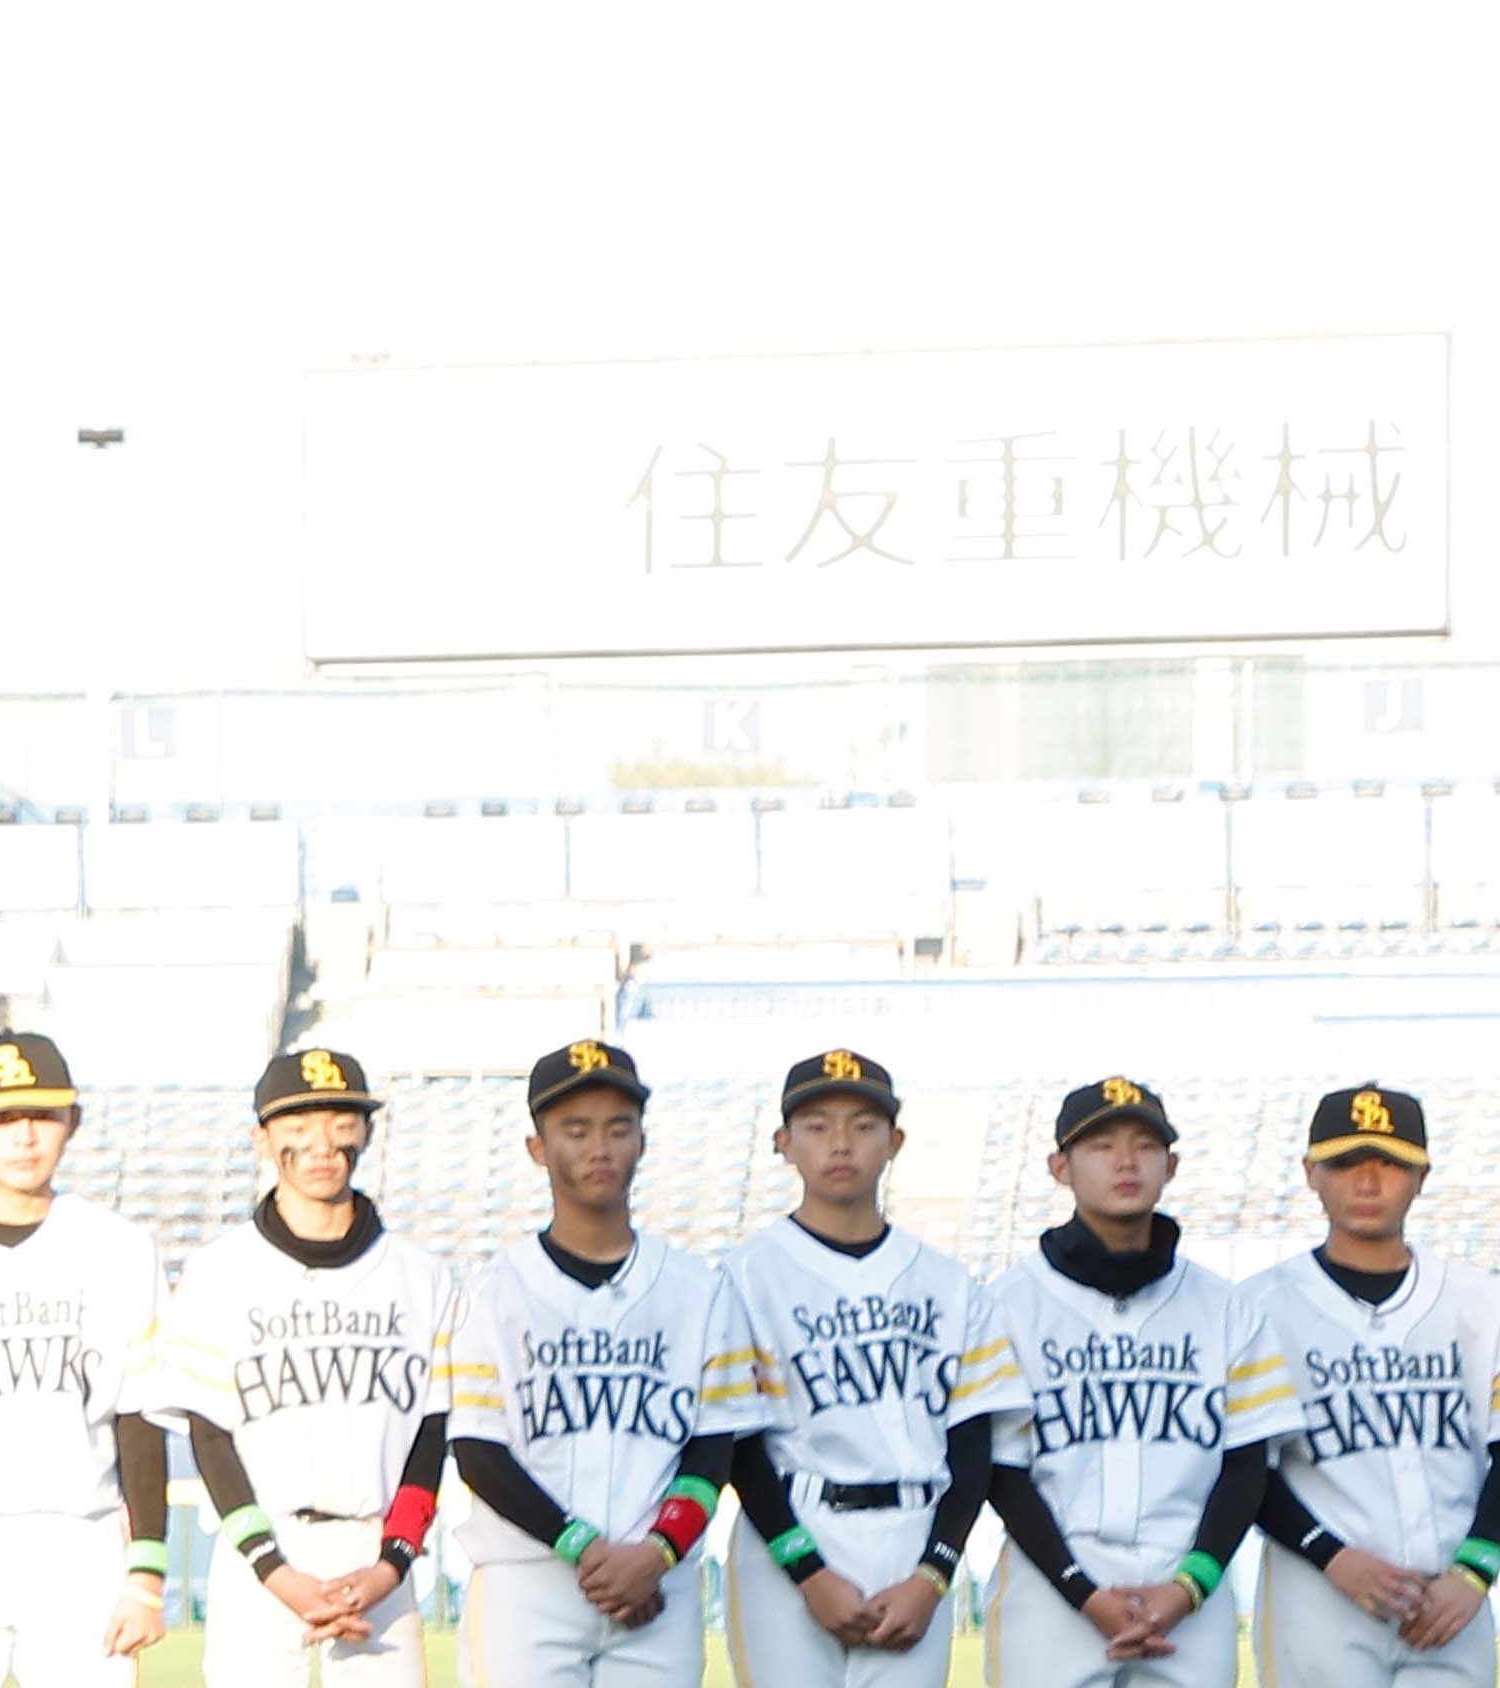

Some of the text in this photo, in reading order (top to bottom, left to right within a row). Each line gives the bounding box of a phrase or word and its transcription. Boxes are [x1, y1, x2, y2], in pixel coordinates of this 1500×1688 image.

[625, 420, 1407, 575] 住友重機械
[712, 704, 756, 751] K
[1374, 680, 1409, 731] J
[131, 713, 166, 753] L
[248, 1300, 405, 1345] SoftBank
[792, 1295, 943, 1341] SoftBank
[1041, 1334, 1199, 1374] SoftBank
[234, 1346, 426, 1422] HAWKS
[1029, 1382, 1225, 1456] HAWKS
[1303, 1392, 1471, 1463] HAWK
